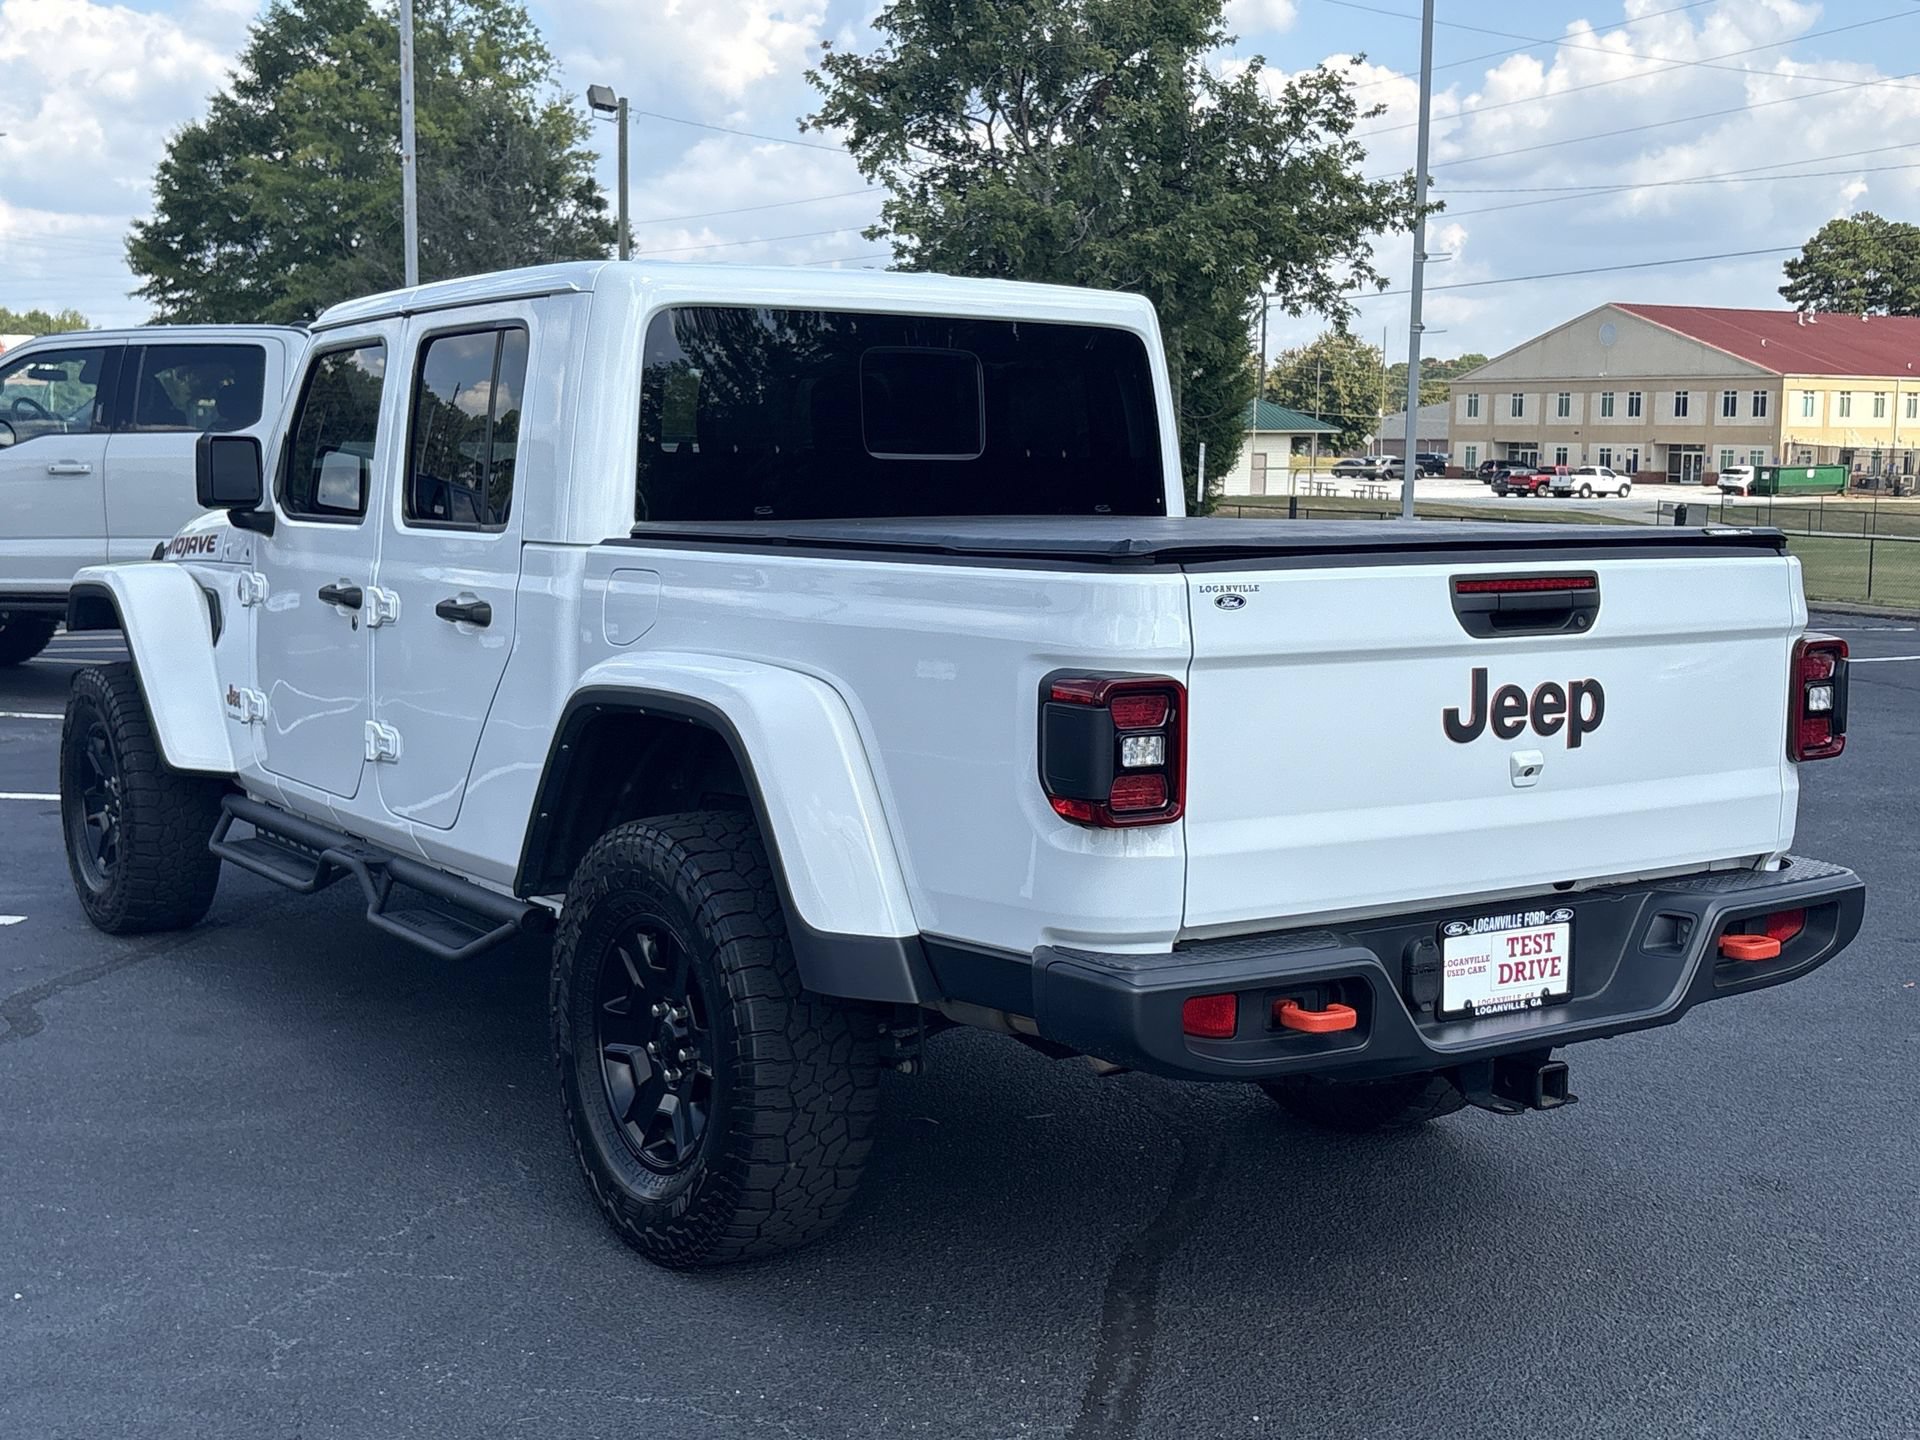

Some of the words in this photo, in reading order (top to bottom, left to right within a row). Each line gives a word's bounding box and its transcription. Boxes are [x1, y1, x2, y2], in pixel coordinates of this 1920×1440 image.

[165, 534, 218, 557] MOJAVE
[1199, 584, 1260, 593] LOGANVILLE
[1218, 596, 1242, 608] Ford
[1443, 667, 1605, 749] Jeep
[1473, 913, 1522, 932] LOGANVILLE
[1524, 910, 1546, 927] FORD
[1506, 932, 1556, 958] TEST
[1446, 968, 1465, 977] USED
[1467, 965, 1486, 975] CARS
[1498, 956, 1562, 985] DRIVE
[1475, 1001, 1528, 1016] LOGANVILLE,
[1530, 998, 1543, 1007] GA
